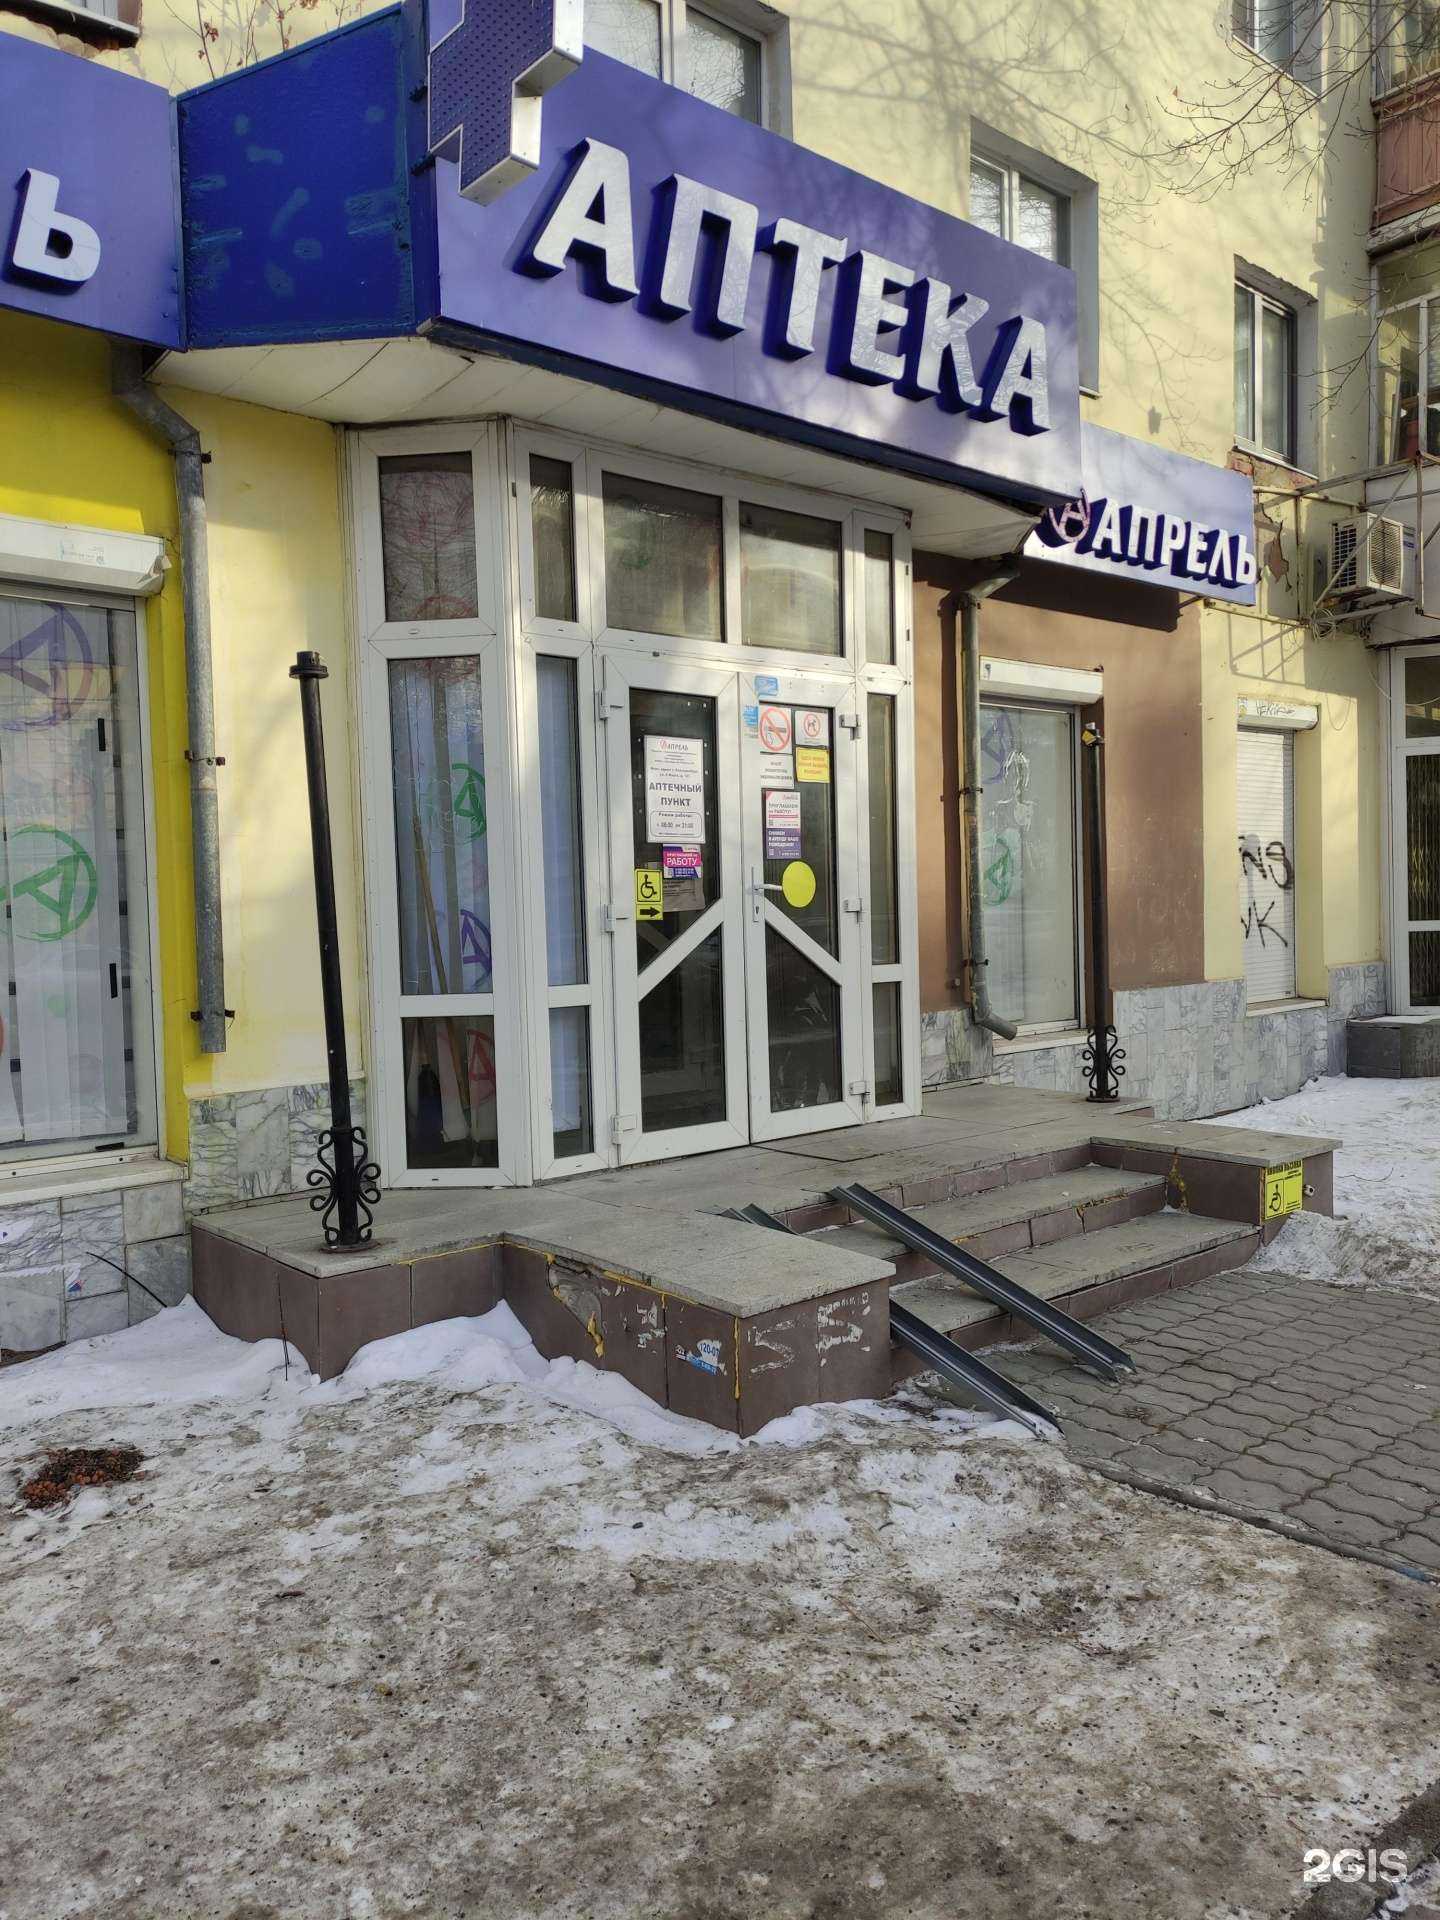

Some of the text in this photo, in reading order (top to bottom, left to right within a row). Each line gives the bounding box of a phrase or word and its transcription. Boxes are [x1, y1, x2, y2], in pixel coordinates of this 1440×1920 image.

[522, 137, 1050, 434] АПТЕКА
[1090, 498, 1257, 585] АПРЕЛЬ
[649, 782, 702, 793] АПТЕЧНЫЙ
[661, 797, 691, 806] ПУНКТ
[666, 857, 698, 867] РАБОТУ
